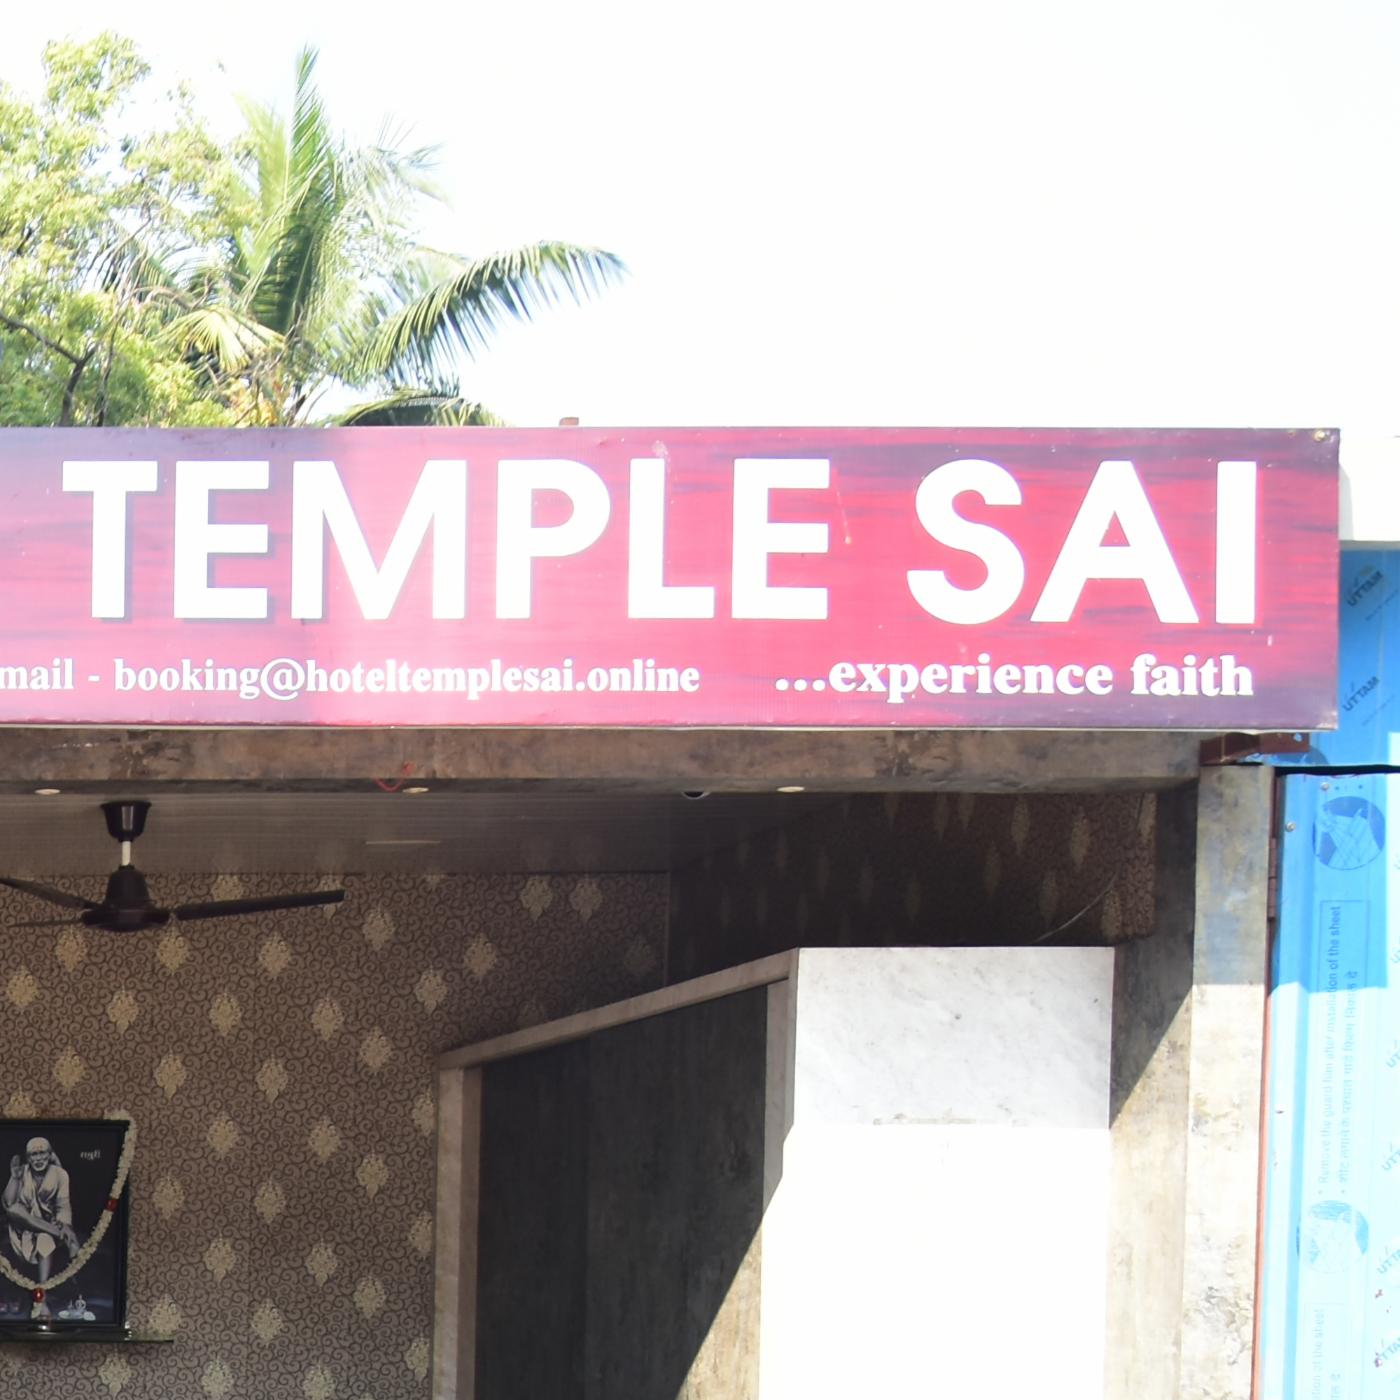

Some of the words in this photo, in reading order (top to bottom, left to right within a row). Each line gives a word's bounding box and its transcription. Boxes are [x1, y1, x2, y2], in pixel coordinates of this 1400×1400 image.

[61, 458, 831, 622] TEMPLE
[906, 458, 1258, 626] SAI
[1346, 570, 1384, 607] UTTAM
[113, 657, 701, 701] booking@hoteltemplesai.online
[774, 653, 1114, 703] ...experience
[1129, 652, 1255, 698] faith
[1342, 675, 1380, 712] UTTAM
[1328, 905, 1341, 936] sheet
[1327, 939, 1339, 956] the
